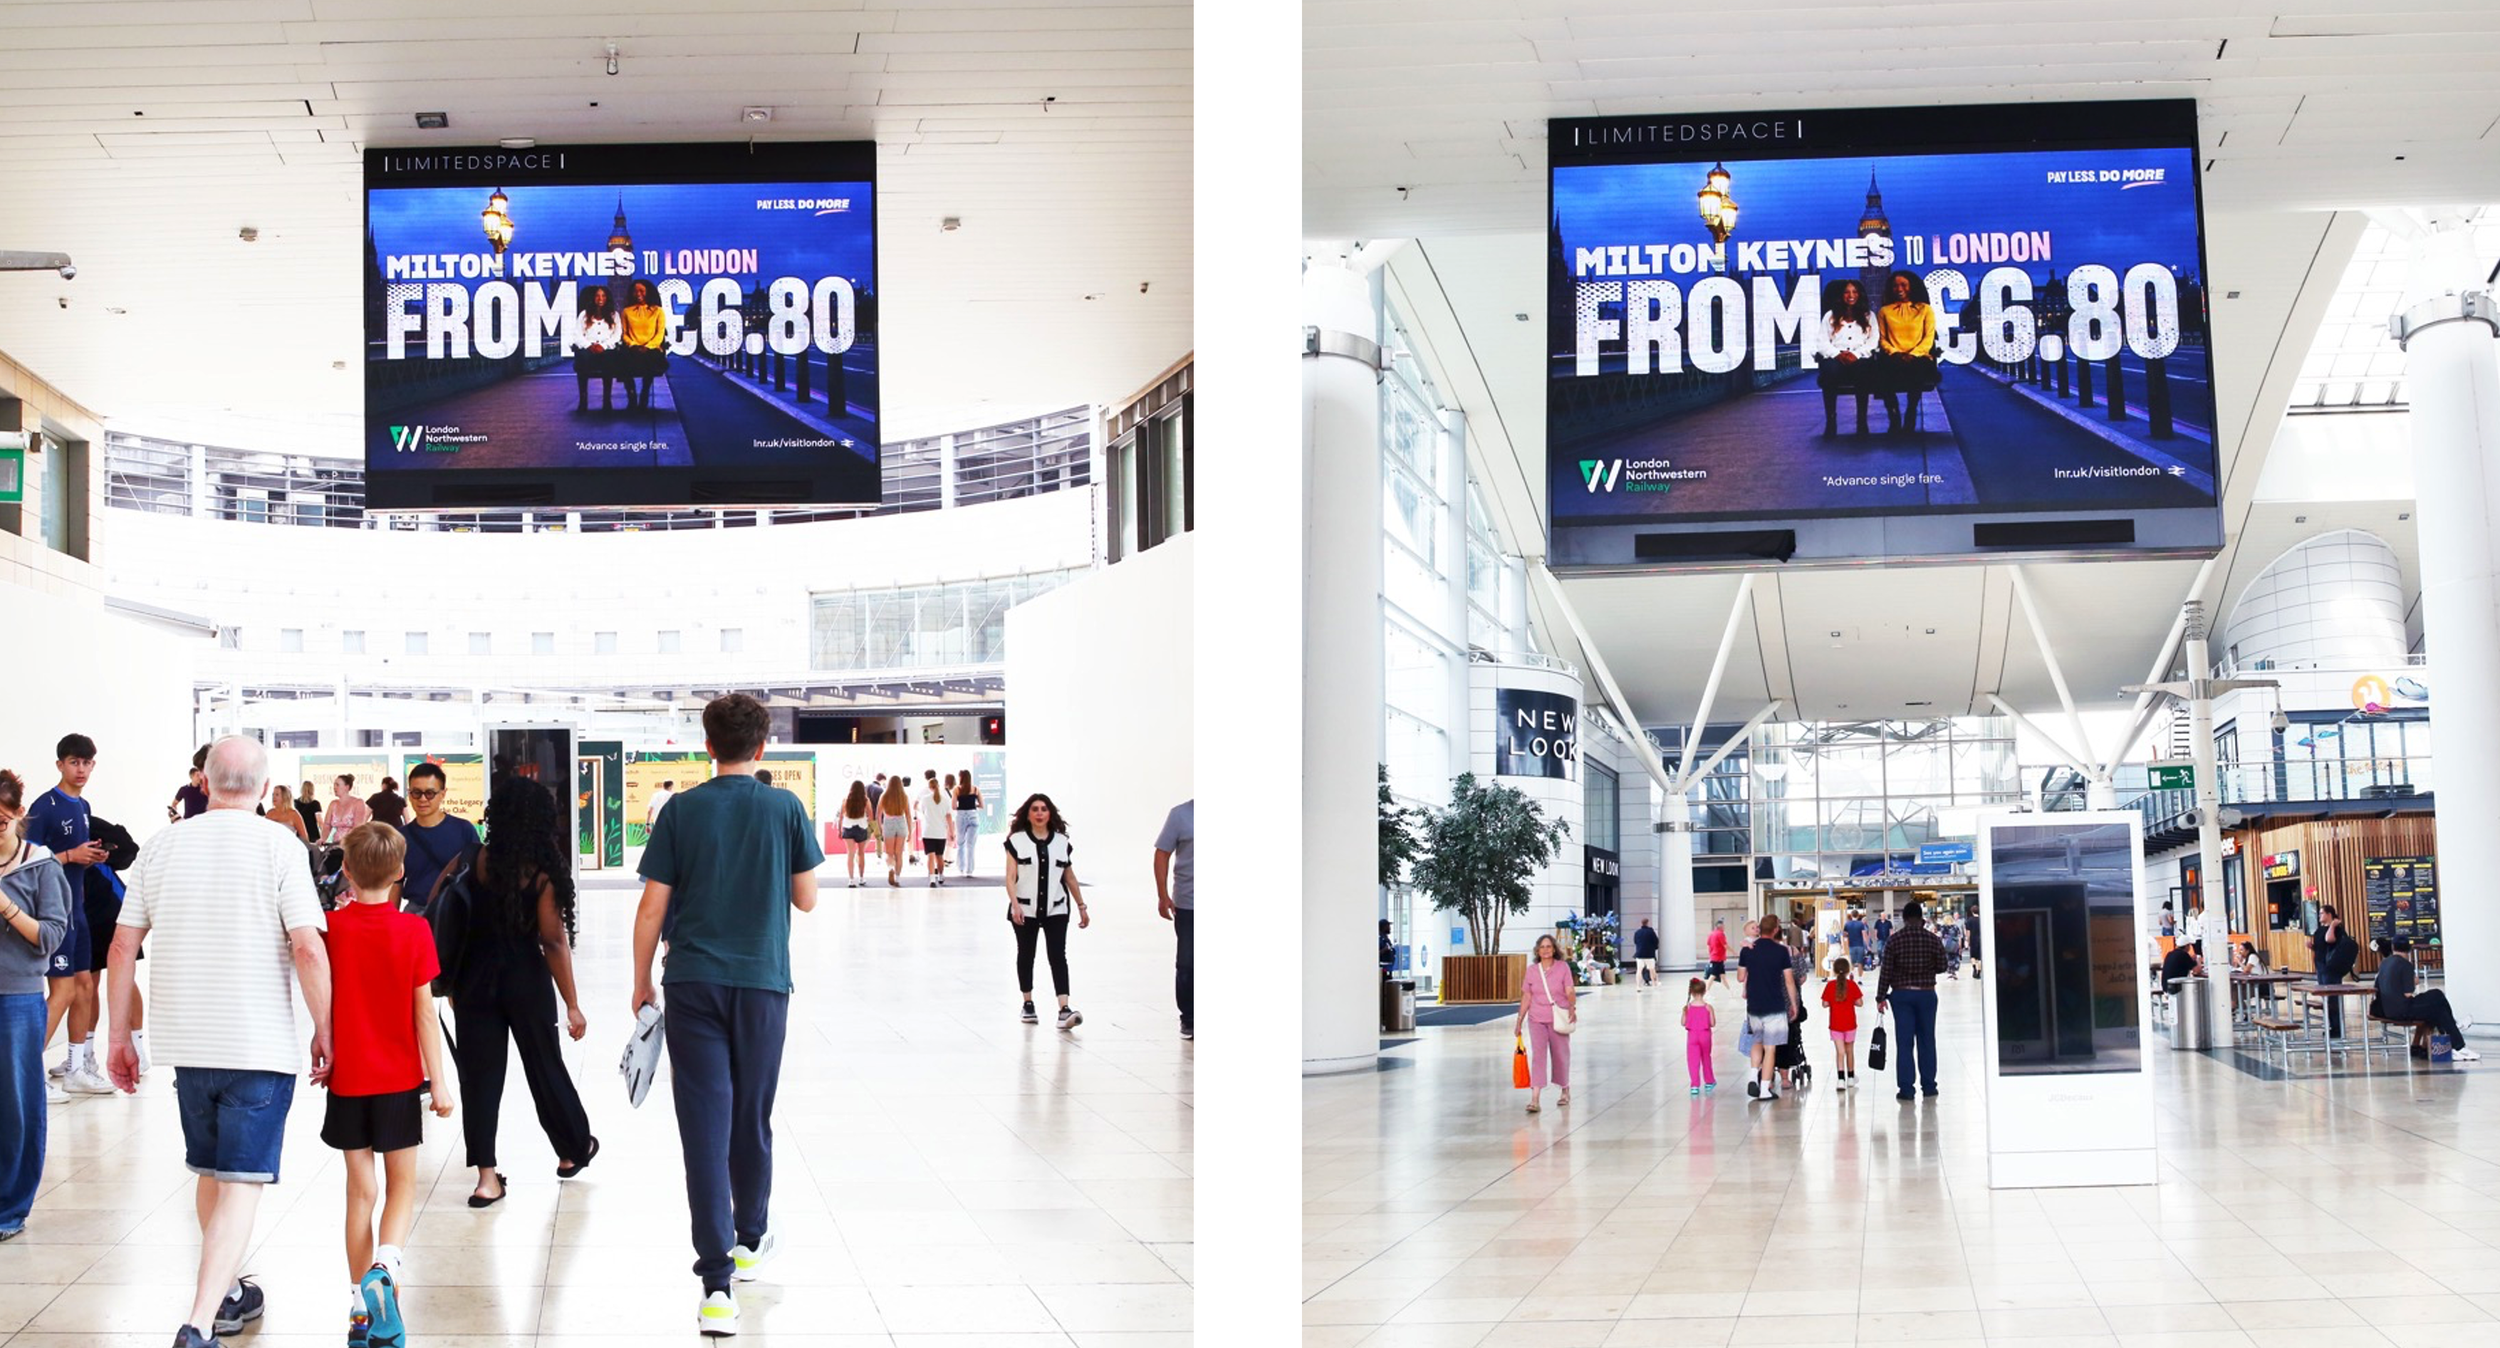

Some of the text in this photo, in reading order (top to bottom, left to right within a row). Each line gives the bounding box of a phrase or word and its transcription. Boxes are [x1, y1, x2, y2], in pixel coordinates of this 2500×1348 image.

[1588, 121, 1786, 145] LIMITEDSPACE
[396, 154, 551, 171] LIMITEDSPACE
[2047, 171, 2067, 183] PAY
[2099, 170, 2120, 182] DO
[2122, 168, 2165, 181] MORE
[757, 200, 773, 210] PAY
[798, 199, 815, 209] DO
[816, 199, 850, 209] MORE
[1576, 231, 2051, 276] MILTON KEYNES TO LONDON
[386, 248, 758, 279] MILTON KEYNES TO LONDON
[386, 281, 577, 360] FROM
[1576, 274, 1822, 377] FROM
[425, 425, 460, 434] London
[425, 434, 488, 443] Northwestern
[753, 438, 835, 448] lnr.uk/visitlondon
[425, 443, 460, 453] Railway
[620, 441, 648, 453] single
[649, 440, 670, 450] fare.
[1625, 458, 1670, 469] London
[1625, 470, 1707, 480] Northwestern
[2054, 465, 2160, 479] lnr.uk/visitlondon
[1625, 481, 1670, 493] Railway
[1880, 473, 1916, 488] single
[1918, 472, 1945, 484] fare.
[1518, 708, 1576, 733] NEW
[1510, 735, 1578, 762] LOOK
[784, 770, 802, 780] OPEN
[460, 799, 483, 807] Legacy
[1592, 856, 1619, 877] NEW LOOK
